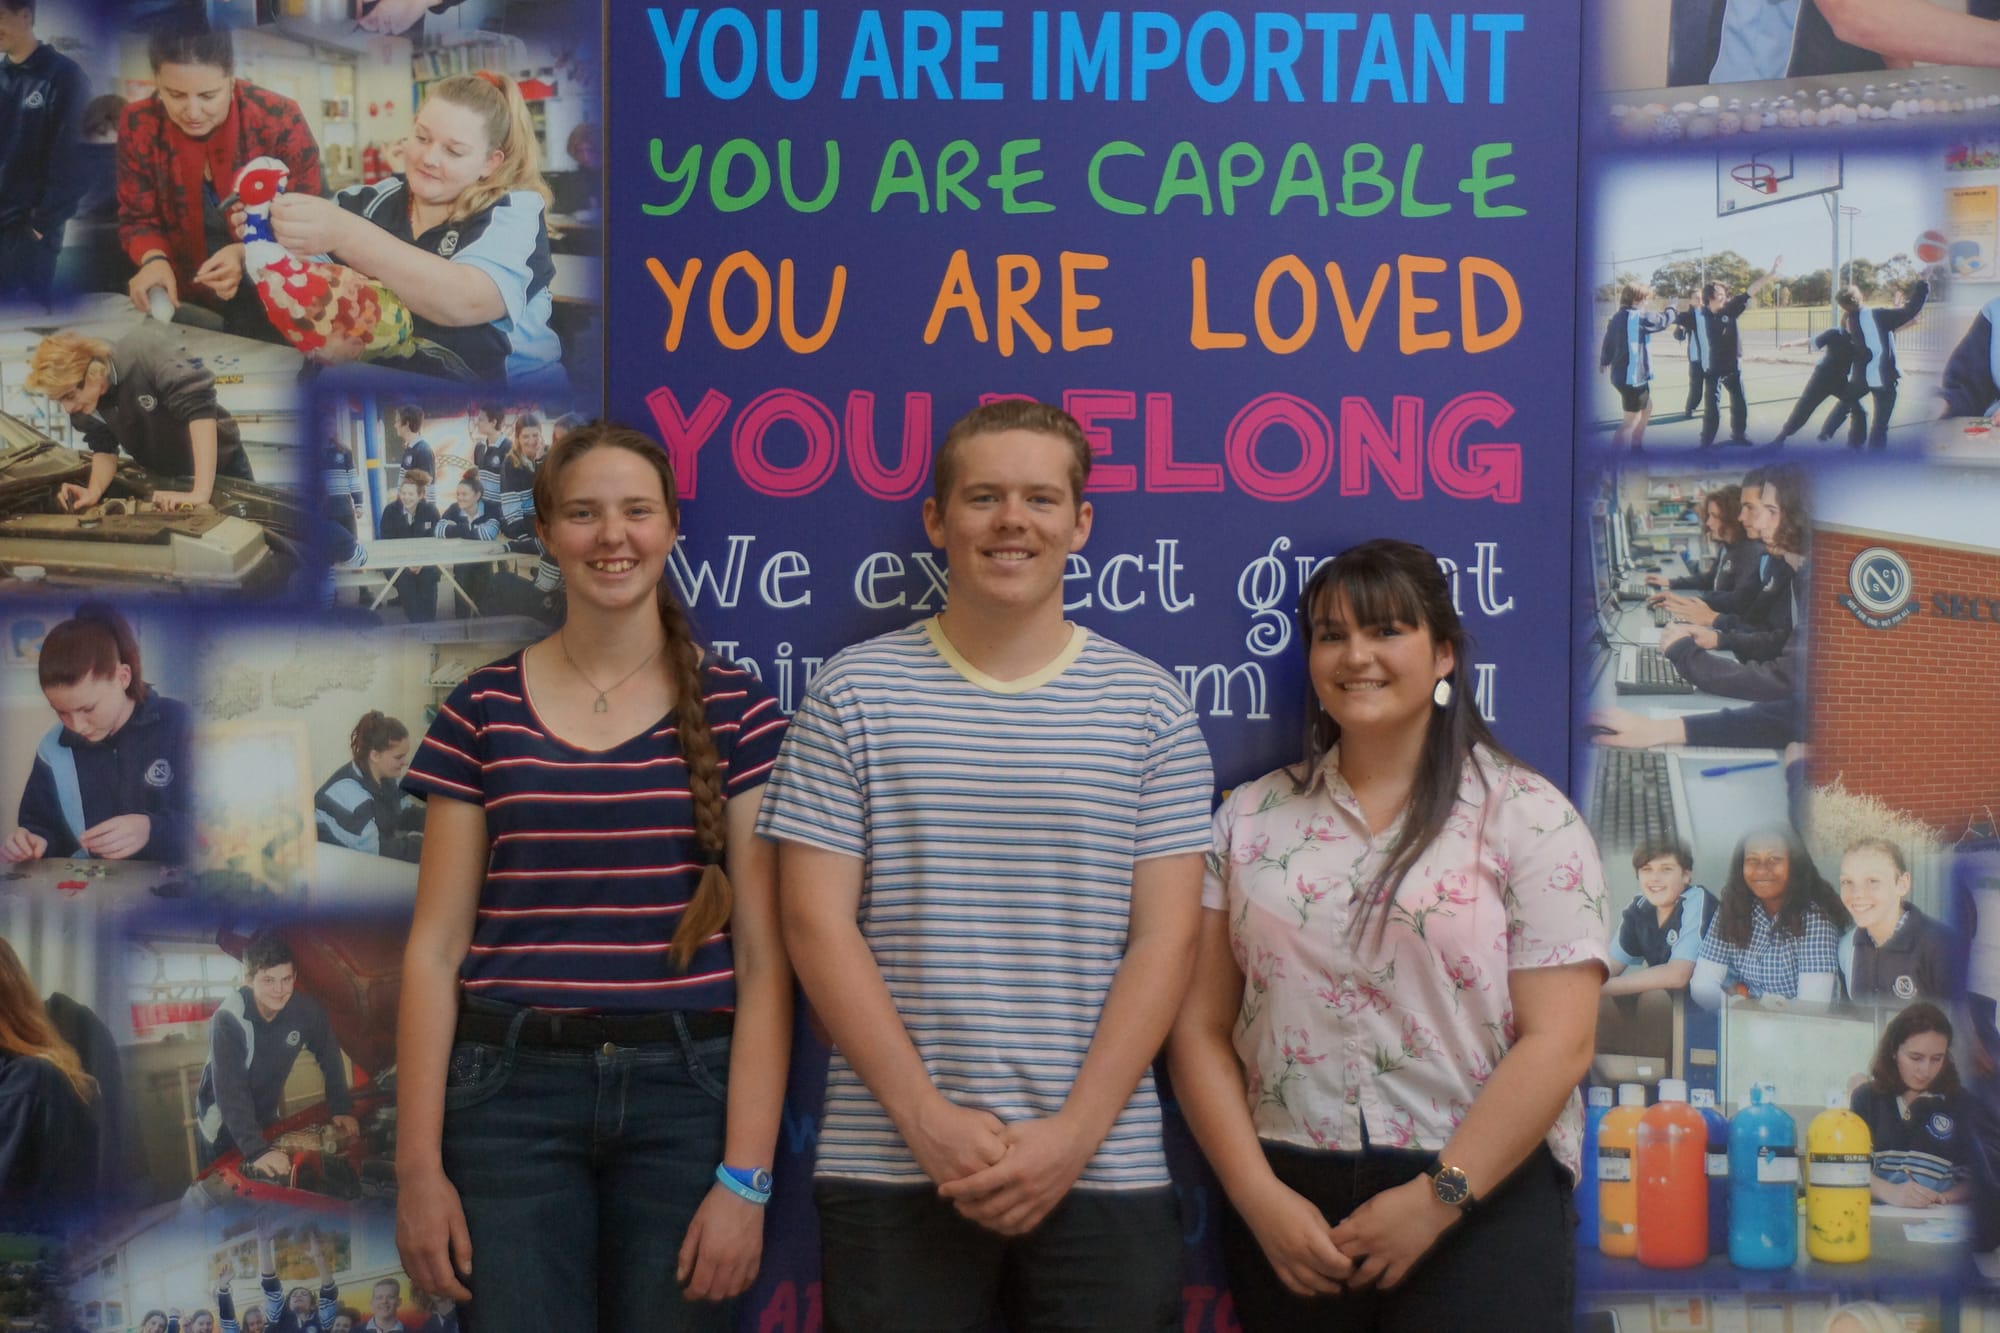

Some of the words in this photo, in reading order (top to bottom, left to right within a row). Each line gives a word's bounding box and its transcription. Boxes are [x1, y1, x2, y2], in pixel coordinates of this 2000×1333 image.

[645, 6, 819, 101] YOU
[839, 8, 1005, 102] ARE
[1030, 9, 1525, 105] IMPORTANT
[641, 138, 840, 216] YOU
[870, 139, 1056, 214] ARE
[1087, 140, 1527, 218] CAPABLE
[645, 250, 847, 354] YOU
[923, 249, 1113, 357] ARE
[1190, 254, 1523, 355] LOVED
[645, 386, 932, 501] YOU
[978, 389, 1522, 504] ELONG
[668, 535, 812, 609] We
[854, 537, 1195, 615] exect
[1237, 535, 1514, 657] grt
